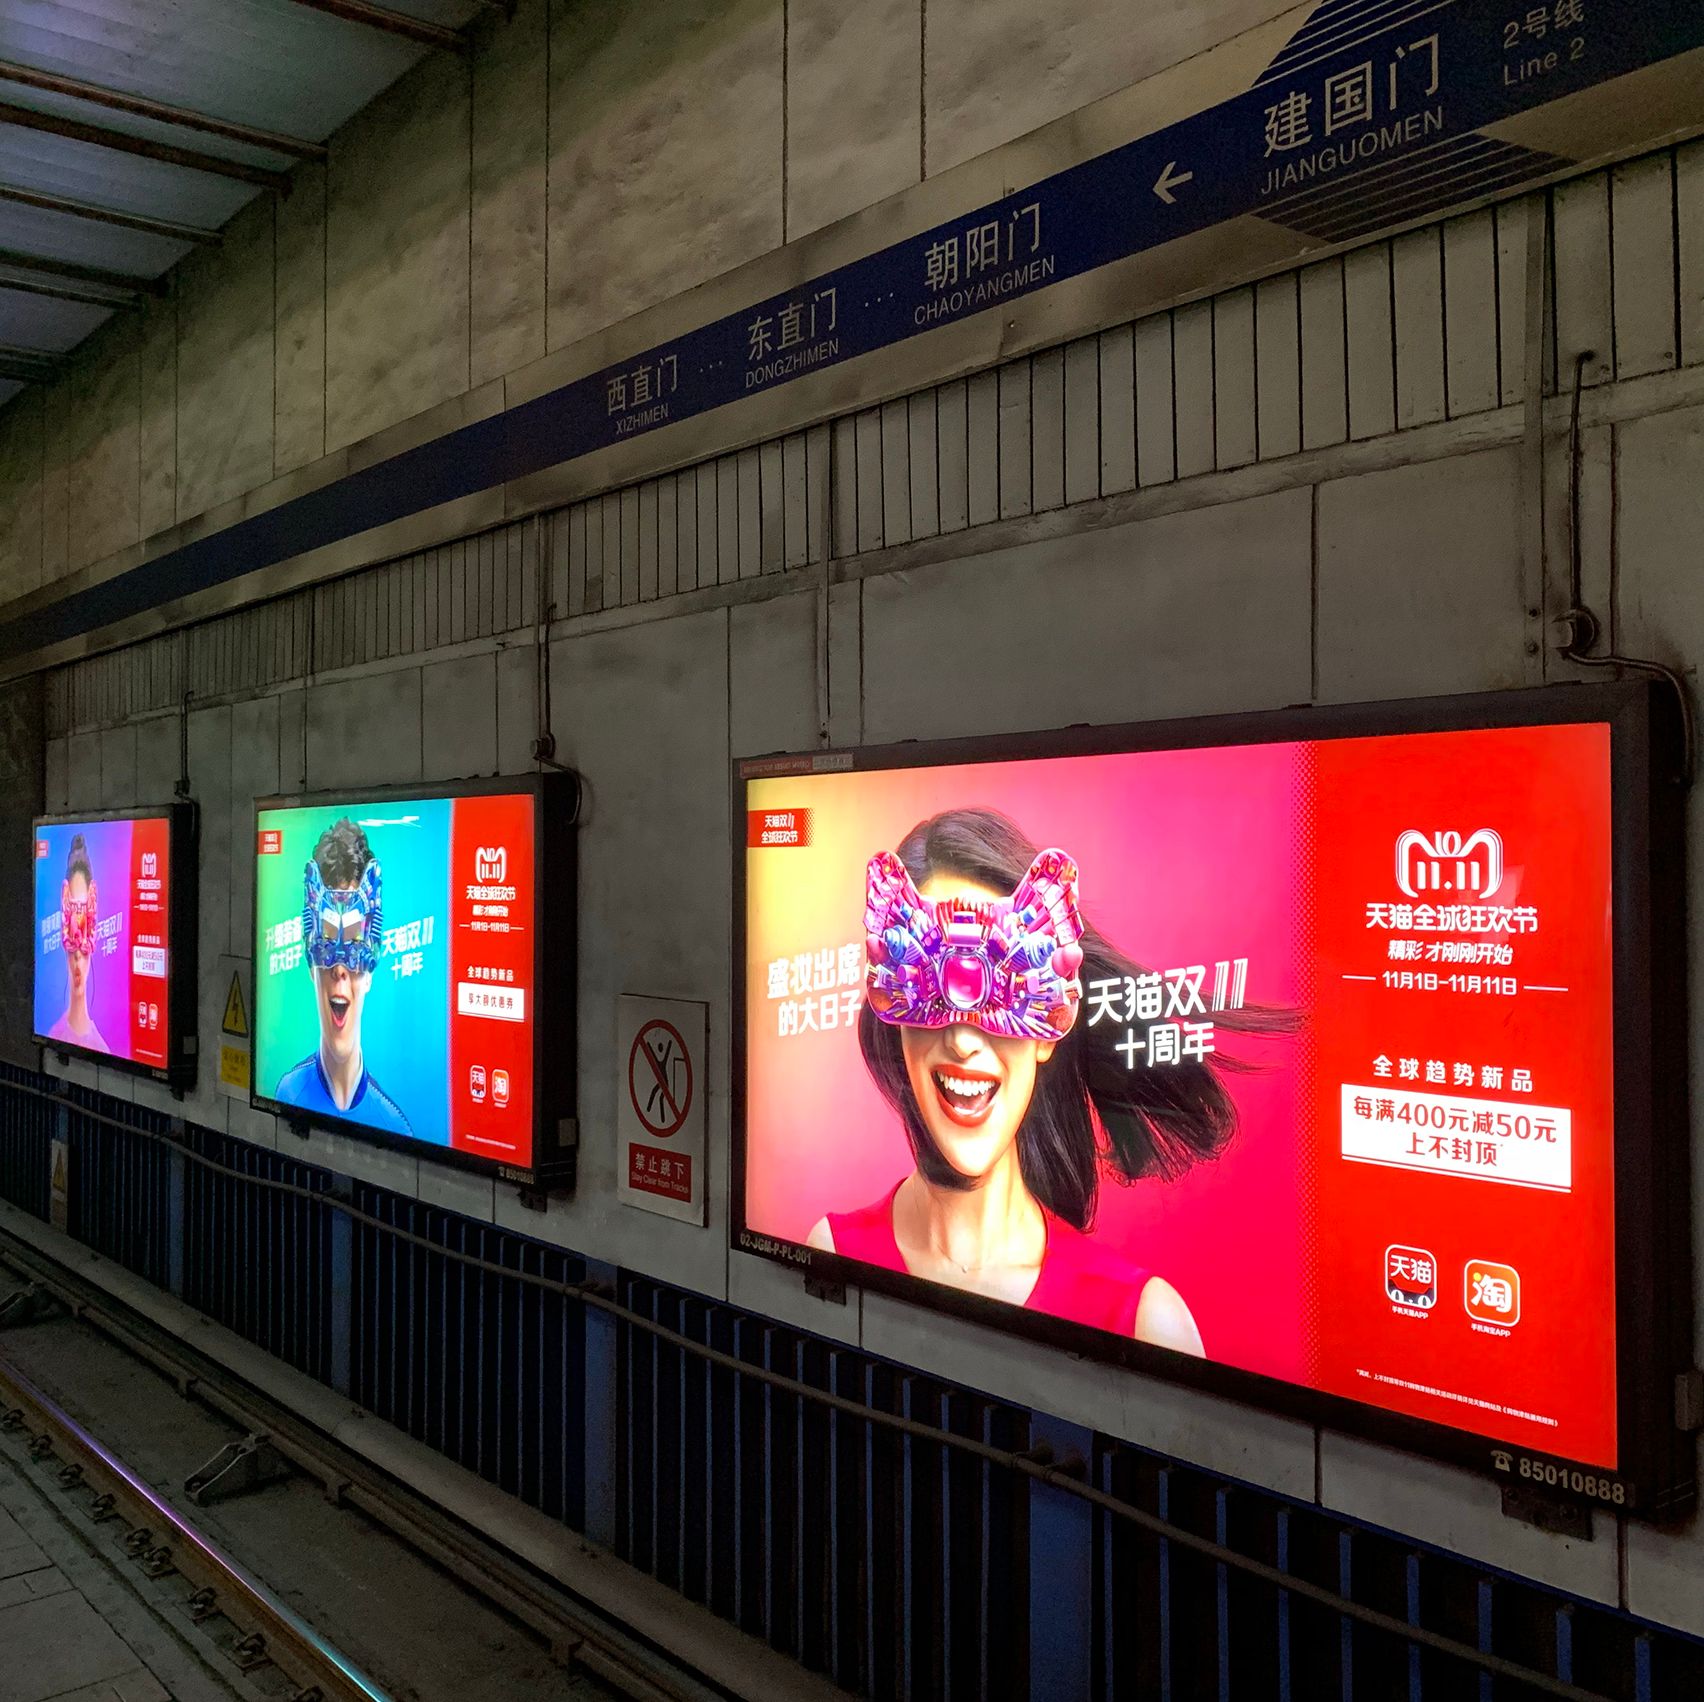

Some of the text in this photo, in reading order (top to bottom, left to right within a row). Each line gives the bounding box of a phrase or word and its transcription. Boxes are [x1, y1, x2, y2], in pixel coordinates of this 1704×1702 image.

[1503, 0, 1585, 49] 2号线
[1503, 37, 1585, 87] Line 2
[1264, 33, 1439, 157] 建国门
[1261, 105, 1443, 195] JIANGUOMEN
[924, 202, 1041, 292] 朝阳门
[913, 254, 1055, 326] CHAOYANGMEN
[748, 287, 838, 361] 东直门
[606, 353, 678, 416] 西直门
[745, 338, 839, 389] DONGZHIMEN
[616, 402, 669, 435] XIZHIMEN
[761, 830, 798, 844] 全球狂欢节
[1366, 902, 1538, 934] 天猫全球狂欢节
[391, 951, 424, 981] 十周年
[767, 942, 861, 999] 盛妆出席
[1382, 970, 1517, 996] 11月1日-11月11日
[778, 989, 861, 1037] 的大日子
[1115, 1021, 1216, 1070] 十周年
[1372, 1054, 1534, 1094] 全球趋势新品
[1353, 1094, 1557, 1144] 每满400元减50元
[634, 1152, 685, 1180] 禁止跳下
[1405, 1132, 1498, 1167] 上不封顶
[1389, 1254, 1433, 1285] 天猫
[1470, 1272, 1513, 1314] 淘
[1519, 1457, 1625, 1505] 85010888
